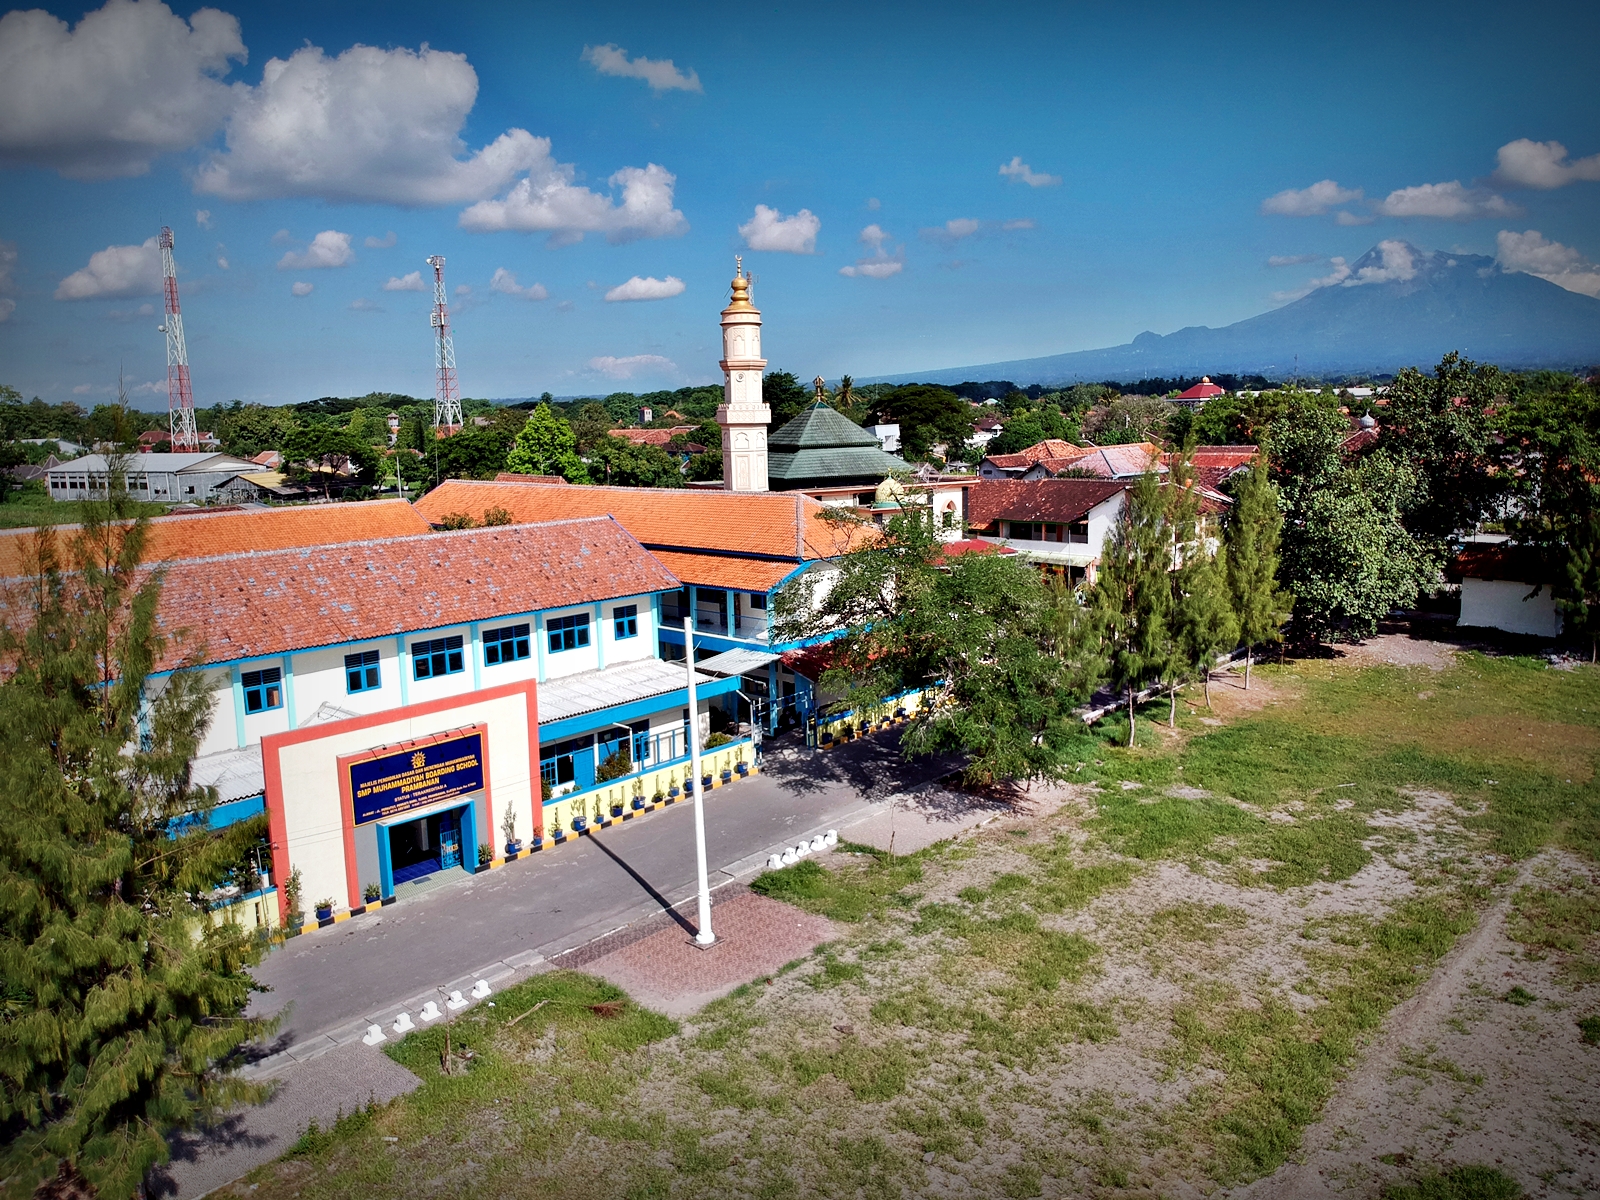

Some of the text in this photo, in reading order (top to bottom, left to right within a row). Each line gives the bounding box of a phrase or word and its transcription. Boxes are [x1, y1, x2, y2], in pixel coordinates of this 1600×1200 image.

[357, 759, 478, 798] SMP MUHAMMADIYAH BOARDING SCHOOL
[360, 780, 377, 788] MAJELIS
[402, 770, 414, 778] DASAR
[402, 777, 440, 794] PRAMBANAN
[413, 785, 444, 797] TERAKREDITASI
